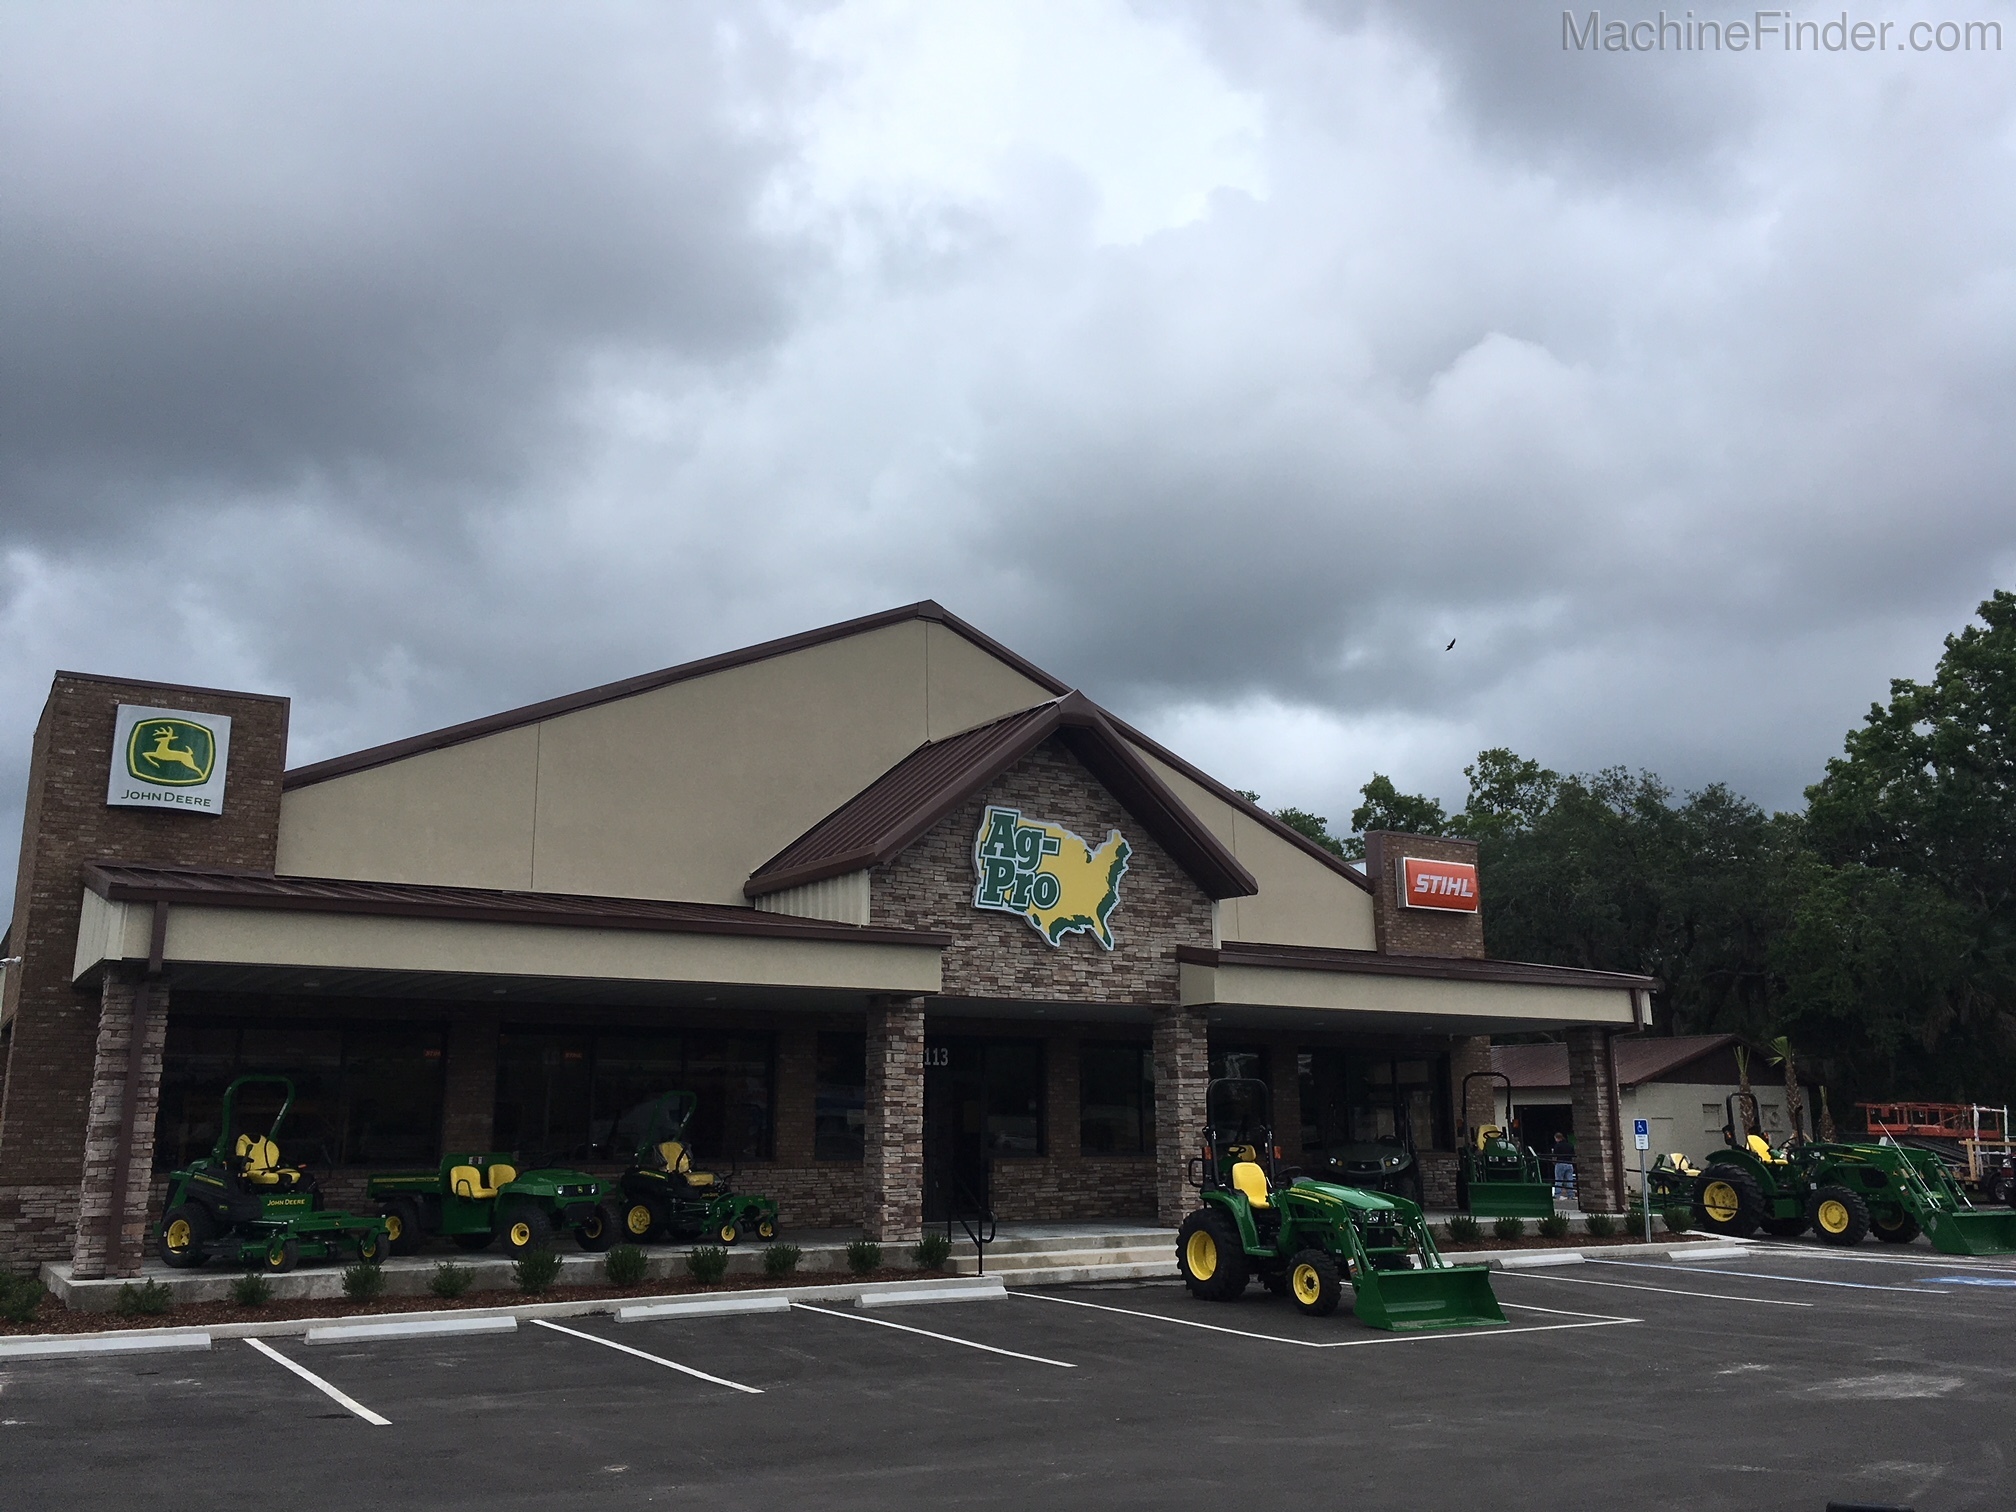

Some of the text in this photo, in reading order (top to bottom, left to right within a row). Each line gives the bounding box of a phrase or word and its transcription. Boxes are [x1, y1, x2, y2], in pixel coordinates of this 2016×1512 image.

[121, 789, 212, 807] JOHN DEERE
[979, 809, 1061, 872] Ag-
[977, 857, 1061, 910] Pro
[1413, 873, 1474, 898] STIHL
[924, 1047, 949, 1066] 113
